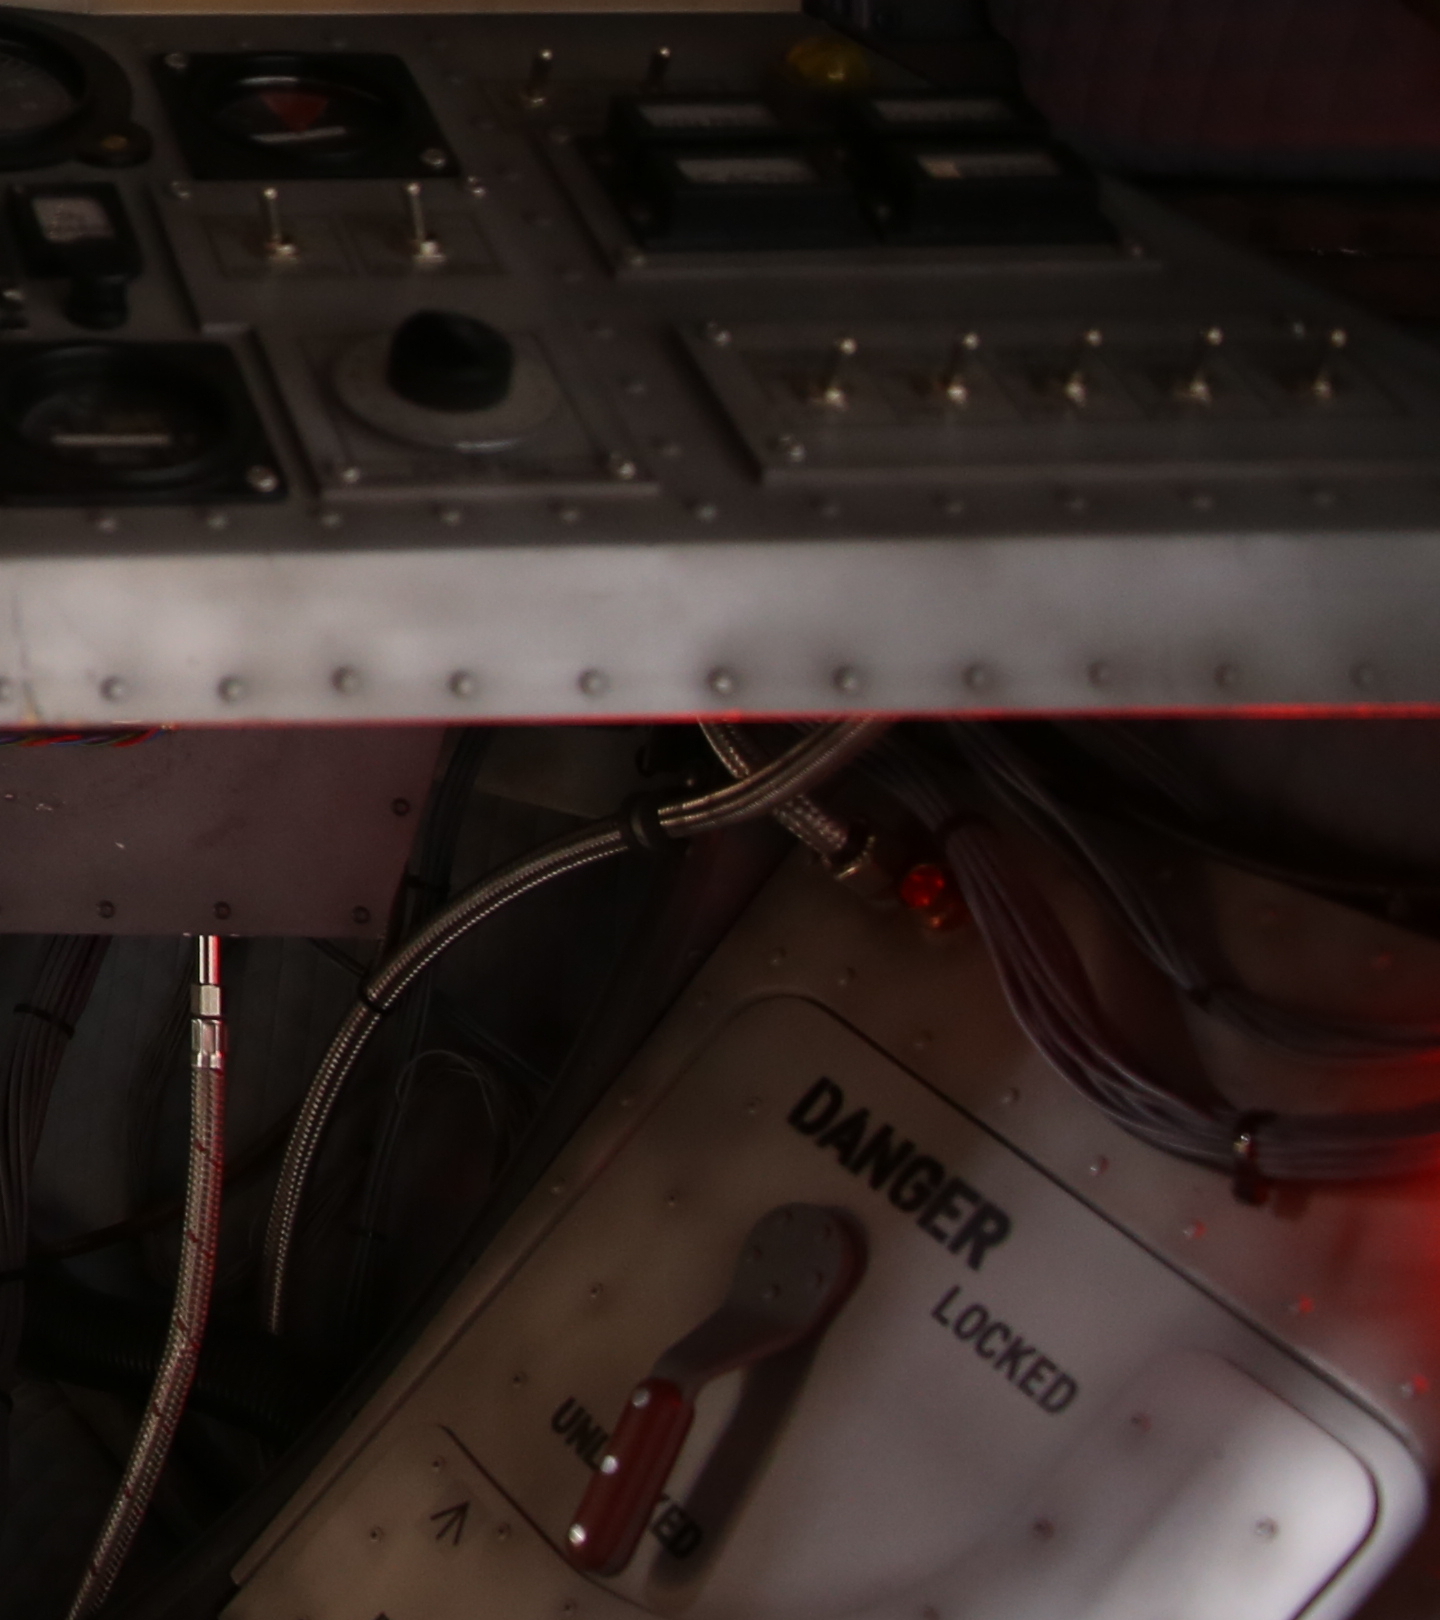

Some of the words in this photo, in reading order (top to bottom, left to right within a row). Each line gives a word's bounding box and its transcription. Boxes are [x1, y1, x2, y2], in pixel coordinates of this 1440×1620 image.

[785, 1074, 1015, 1271] DANGER
[929, 1284, 1081, 1417] LOCKED
[550, 1396, 704, 1560] UNLED
